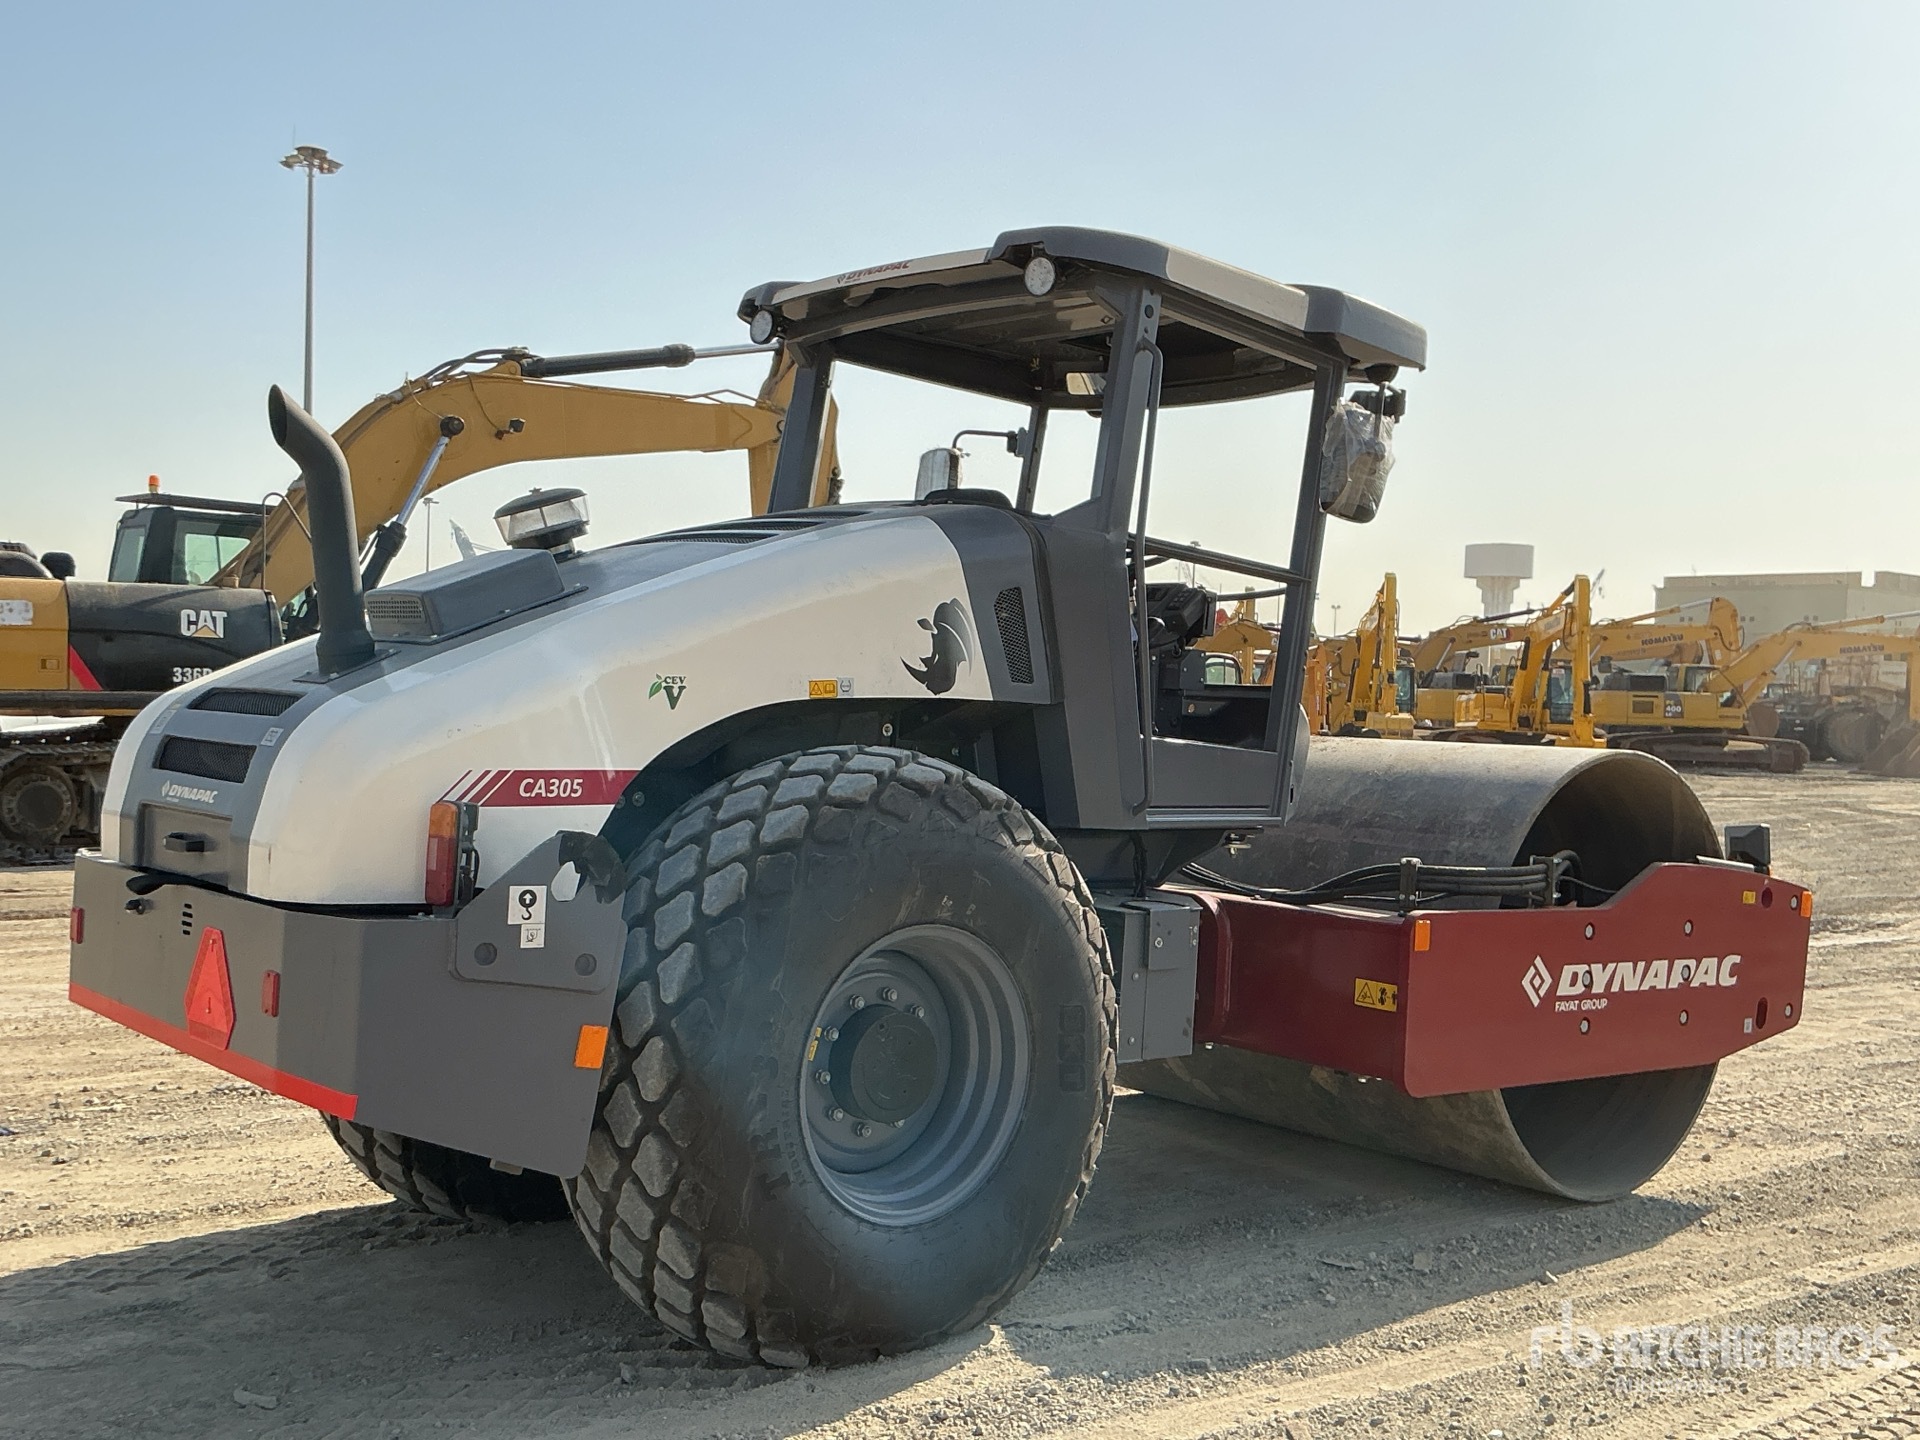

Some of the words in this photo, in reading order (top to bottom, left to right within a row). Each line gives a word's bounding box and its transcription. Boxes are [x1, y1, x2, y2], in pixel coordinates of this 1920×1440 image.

[180, 608, 229, 639] CAT
[1490, 627, 1508, 640] CAT
[1641, 633, 1684, 646] KOMATSU
[664, 675, 687, 685] CEV
[662, 685, 687, 711] V
[1665, 705, 1681, 713] 400
[168, 784, 219, 804] DYNAPAC
[518, 778, 584, 798] CA305
[1556, 954, 1742, 997] DYNAPAC
[1555, 1000, 1580, 1012] FAYAT
[1581, 999, 1608, 1011] GROUP
